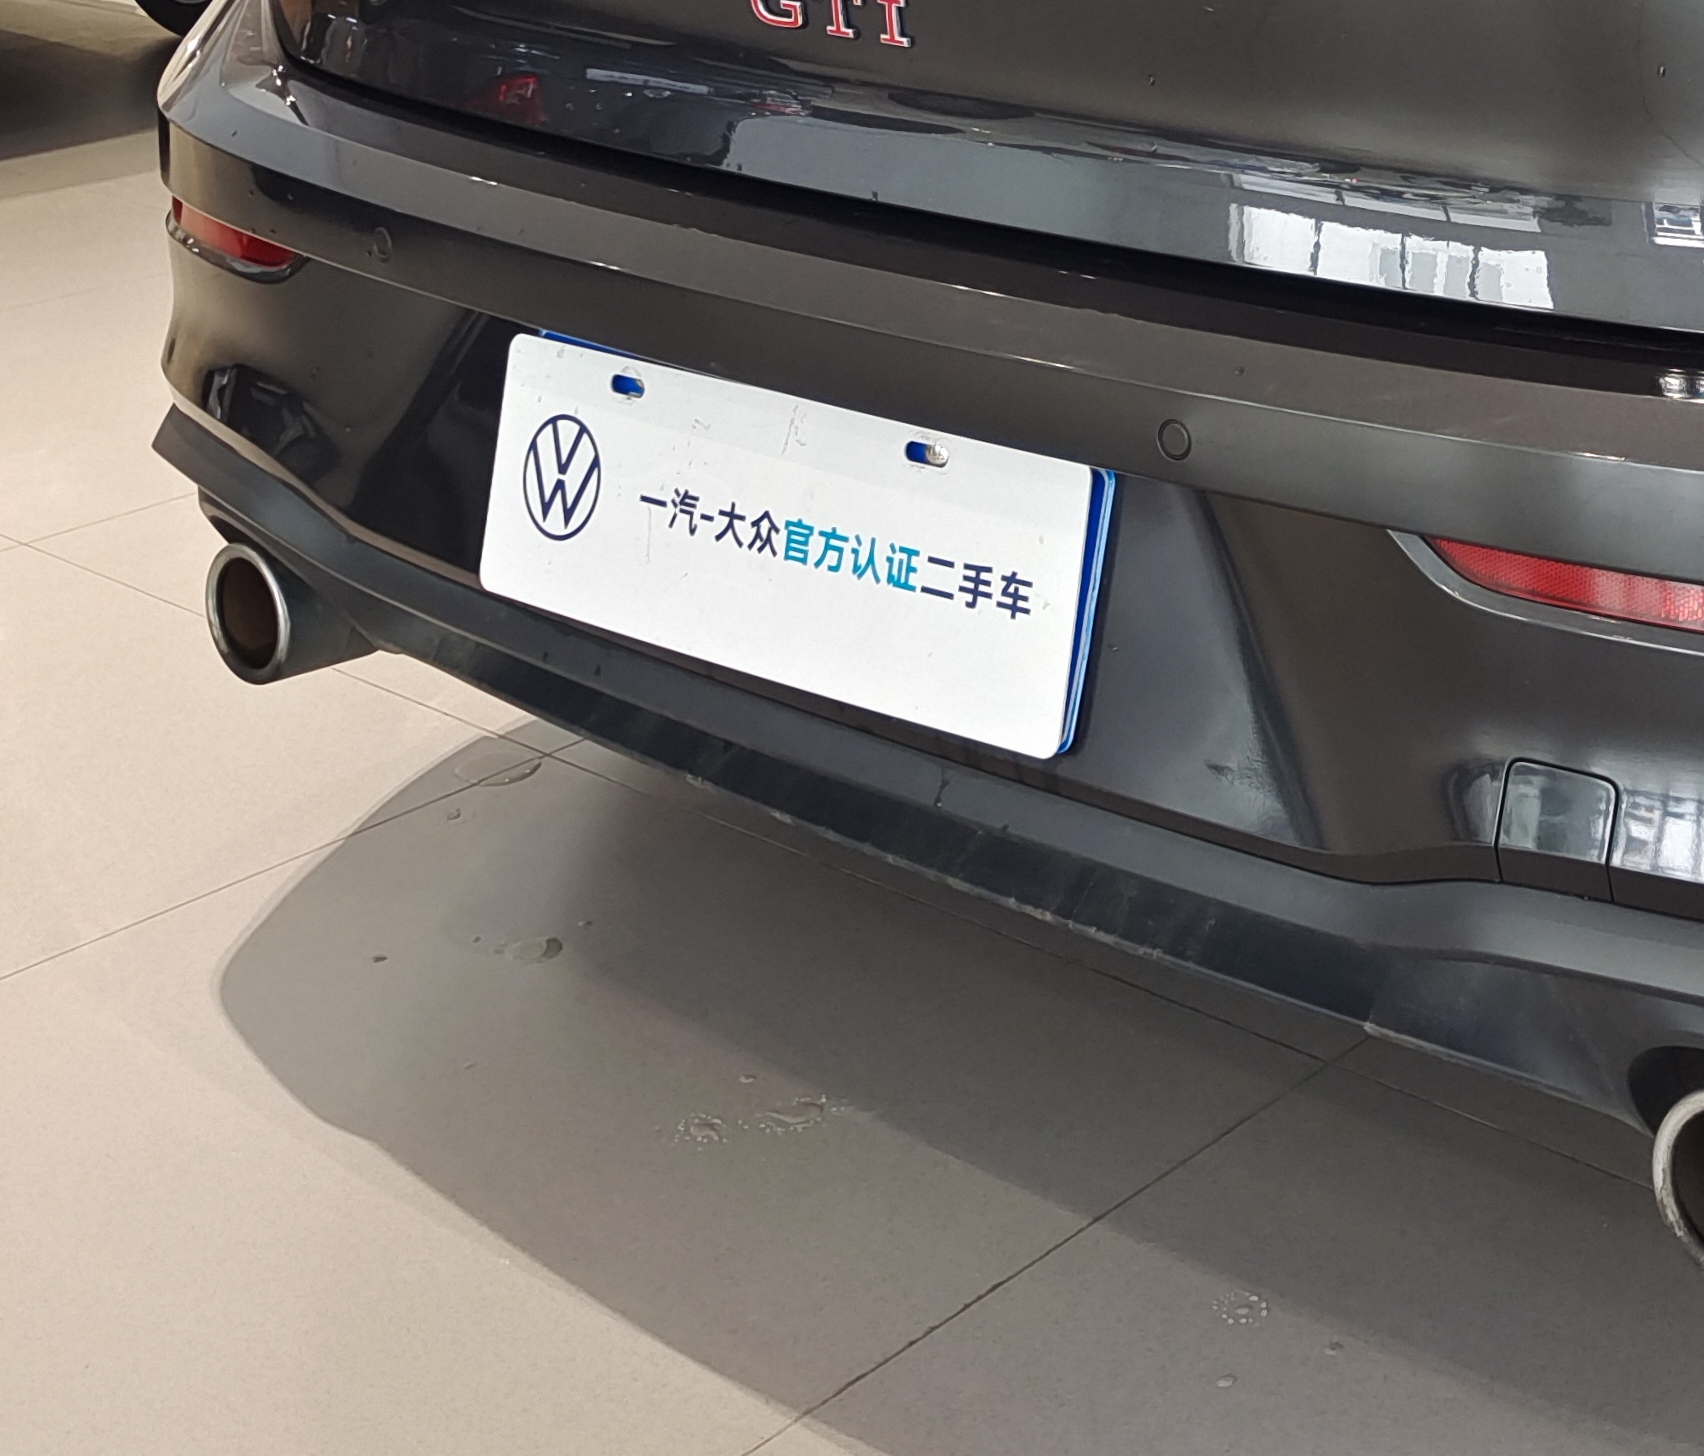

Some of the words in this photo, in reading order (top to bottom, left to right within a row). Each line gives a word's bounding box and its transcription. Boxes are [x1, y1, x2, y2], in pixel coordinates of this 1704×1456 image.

[639, 487, 1034, 620] 一汽-大众官方认证二手车
